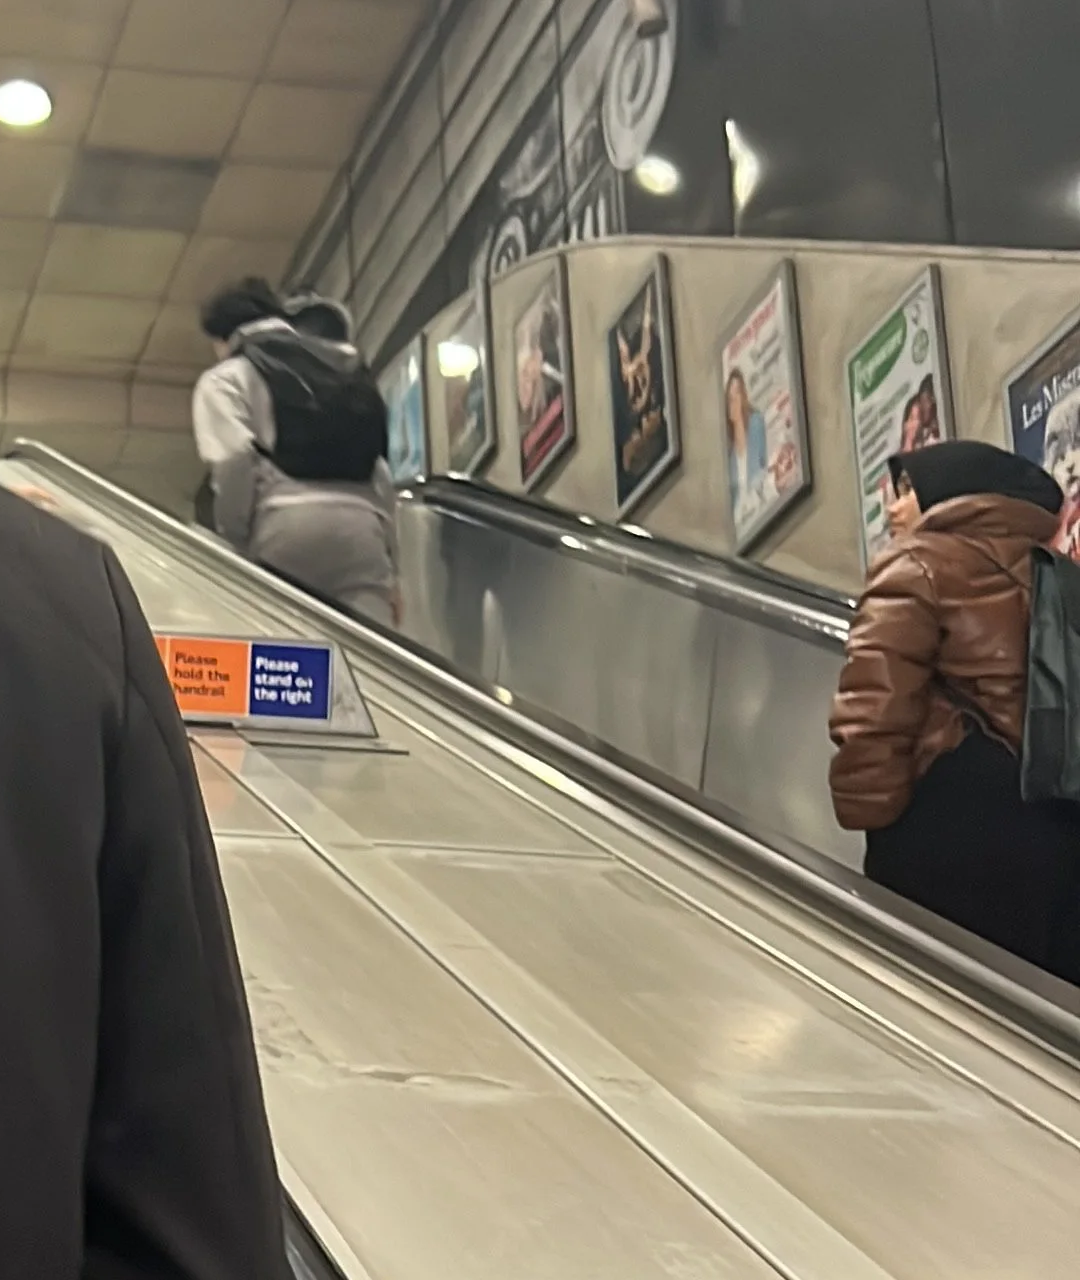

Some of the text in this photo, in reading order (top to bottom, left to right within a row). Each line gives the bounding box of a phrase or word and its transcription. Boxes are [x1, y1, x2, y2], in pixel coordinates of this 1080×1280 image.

[1022, 401, 1043, 429] Les
[175, 652, 218, 666] Please
[255, 656, 299, 673] Please
[174, 668, 230, 682] hold the
[254, 673, 313, 688] stand on
[174, 683, 226, 698] handrail
[254, 687, 312, 705] the right
